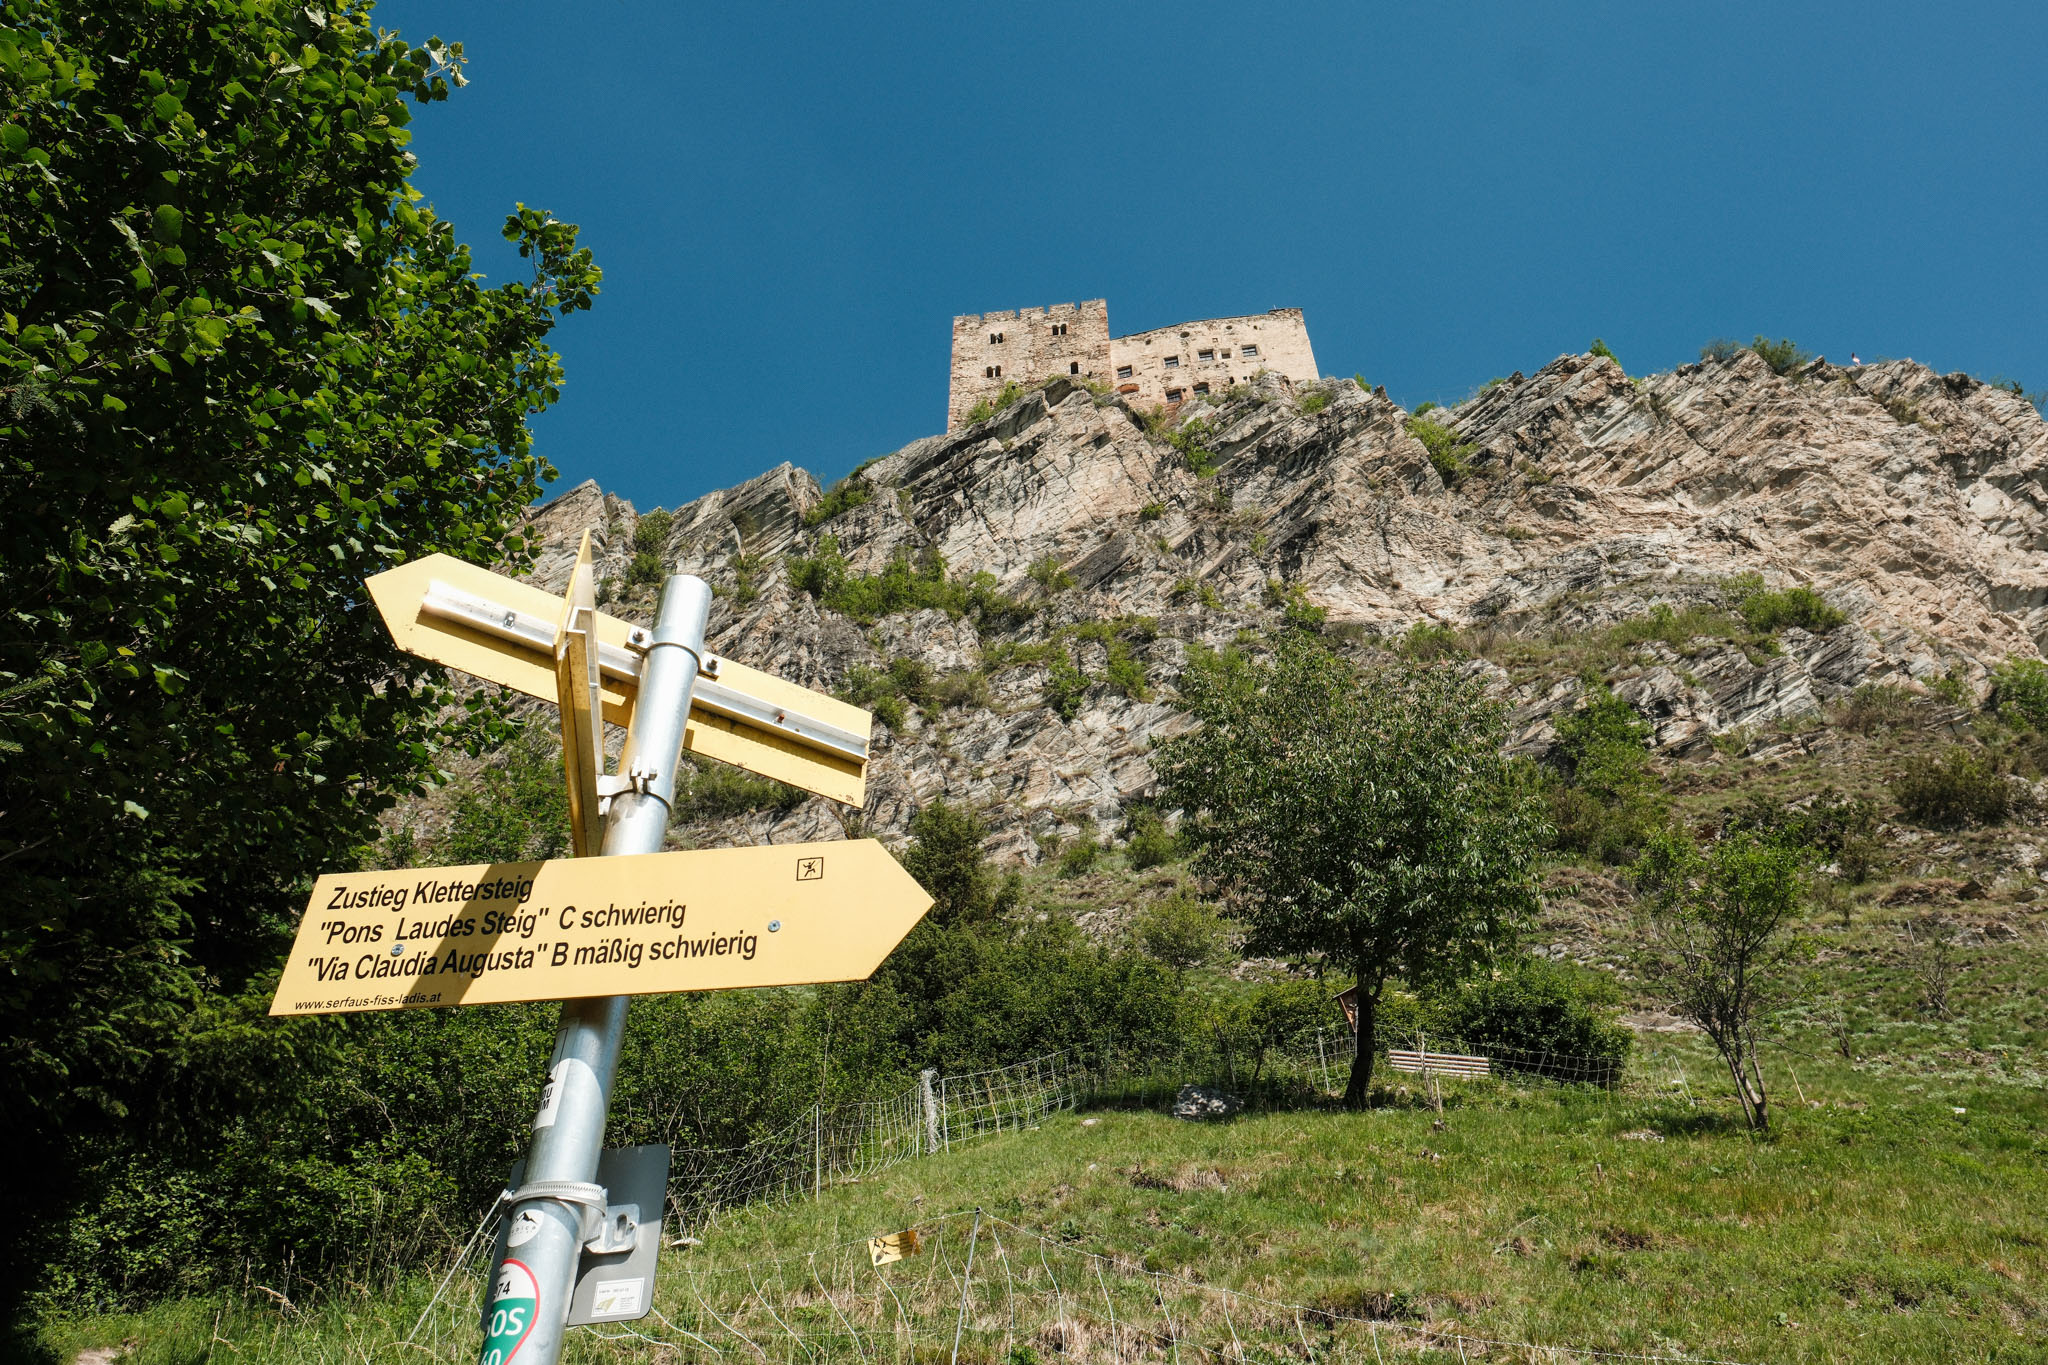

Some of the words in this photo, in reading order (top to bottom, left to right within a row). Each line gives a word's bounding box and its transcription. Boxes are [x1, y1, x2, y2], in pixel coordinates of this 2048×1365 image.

[327, 884, 408, 912] Zustieg
[412, 875, 534, 904] Klettersteig
[320, 921, 384, 945] "Pons
[395, 914, 475, 941] Laudes
[481, 908, 549, 939] Steig"
[559, 906, 576, 930] C
[580, 899, 686, 928] schwierig
[307, 957, 350, 982] "Via
[354, 950, 436, 980] Claudia
[440, 943, 547, 979] Augusta"
[551, 942, 568, 967] B
[573, 937, 643, 968] mäßig
[649, 930, 757, 960] schwierig
[295, 992, 441, 1010] www.serfaus-fiss-ladis.at
